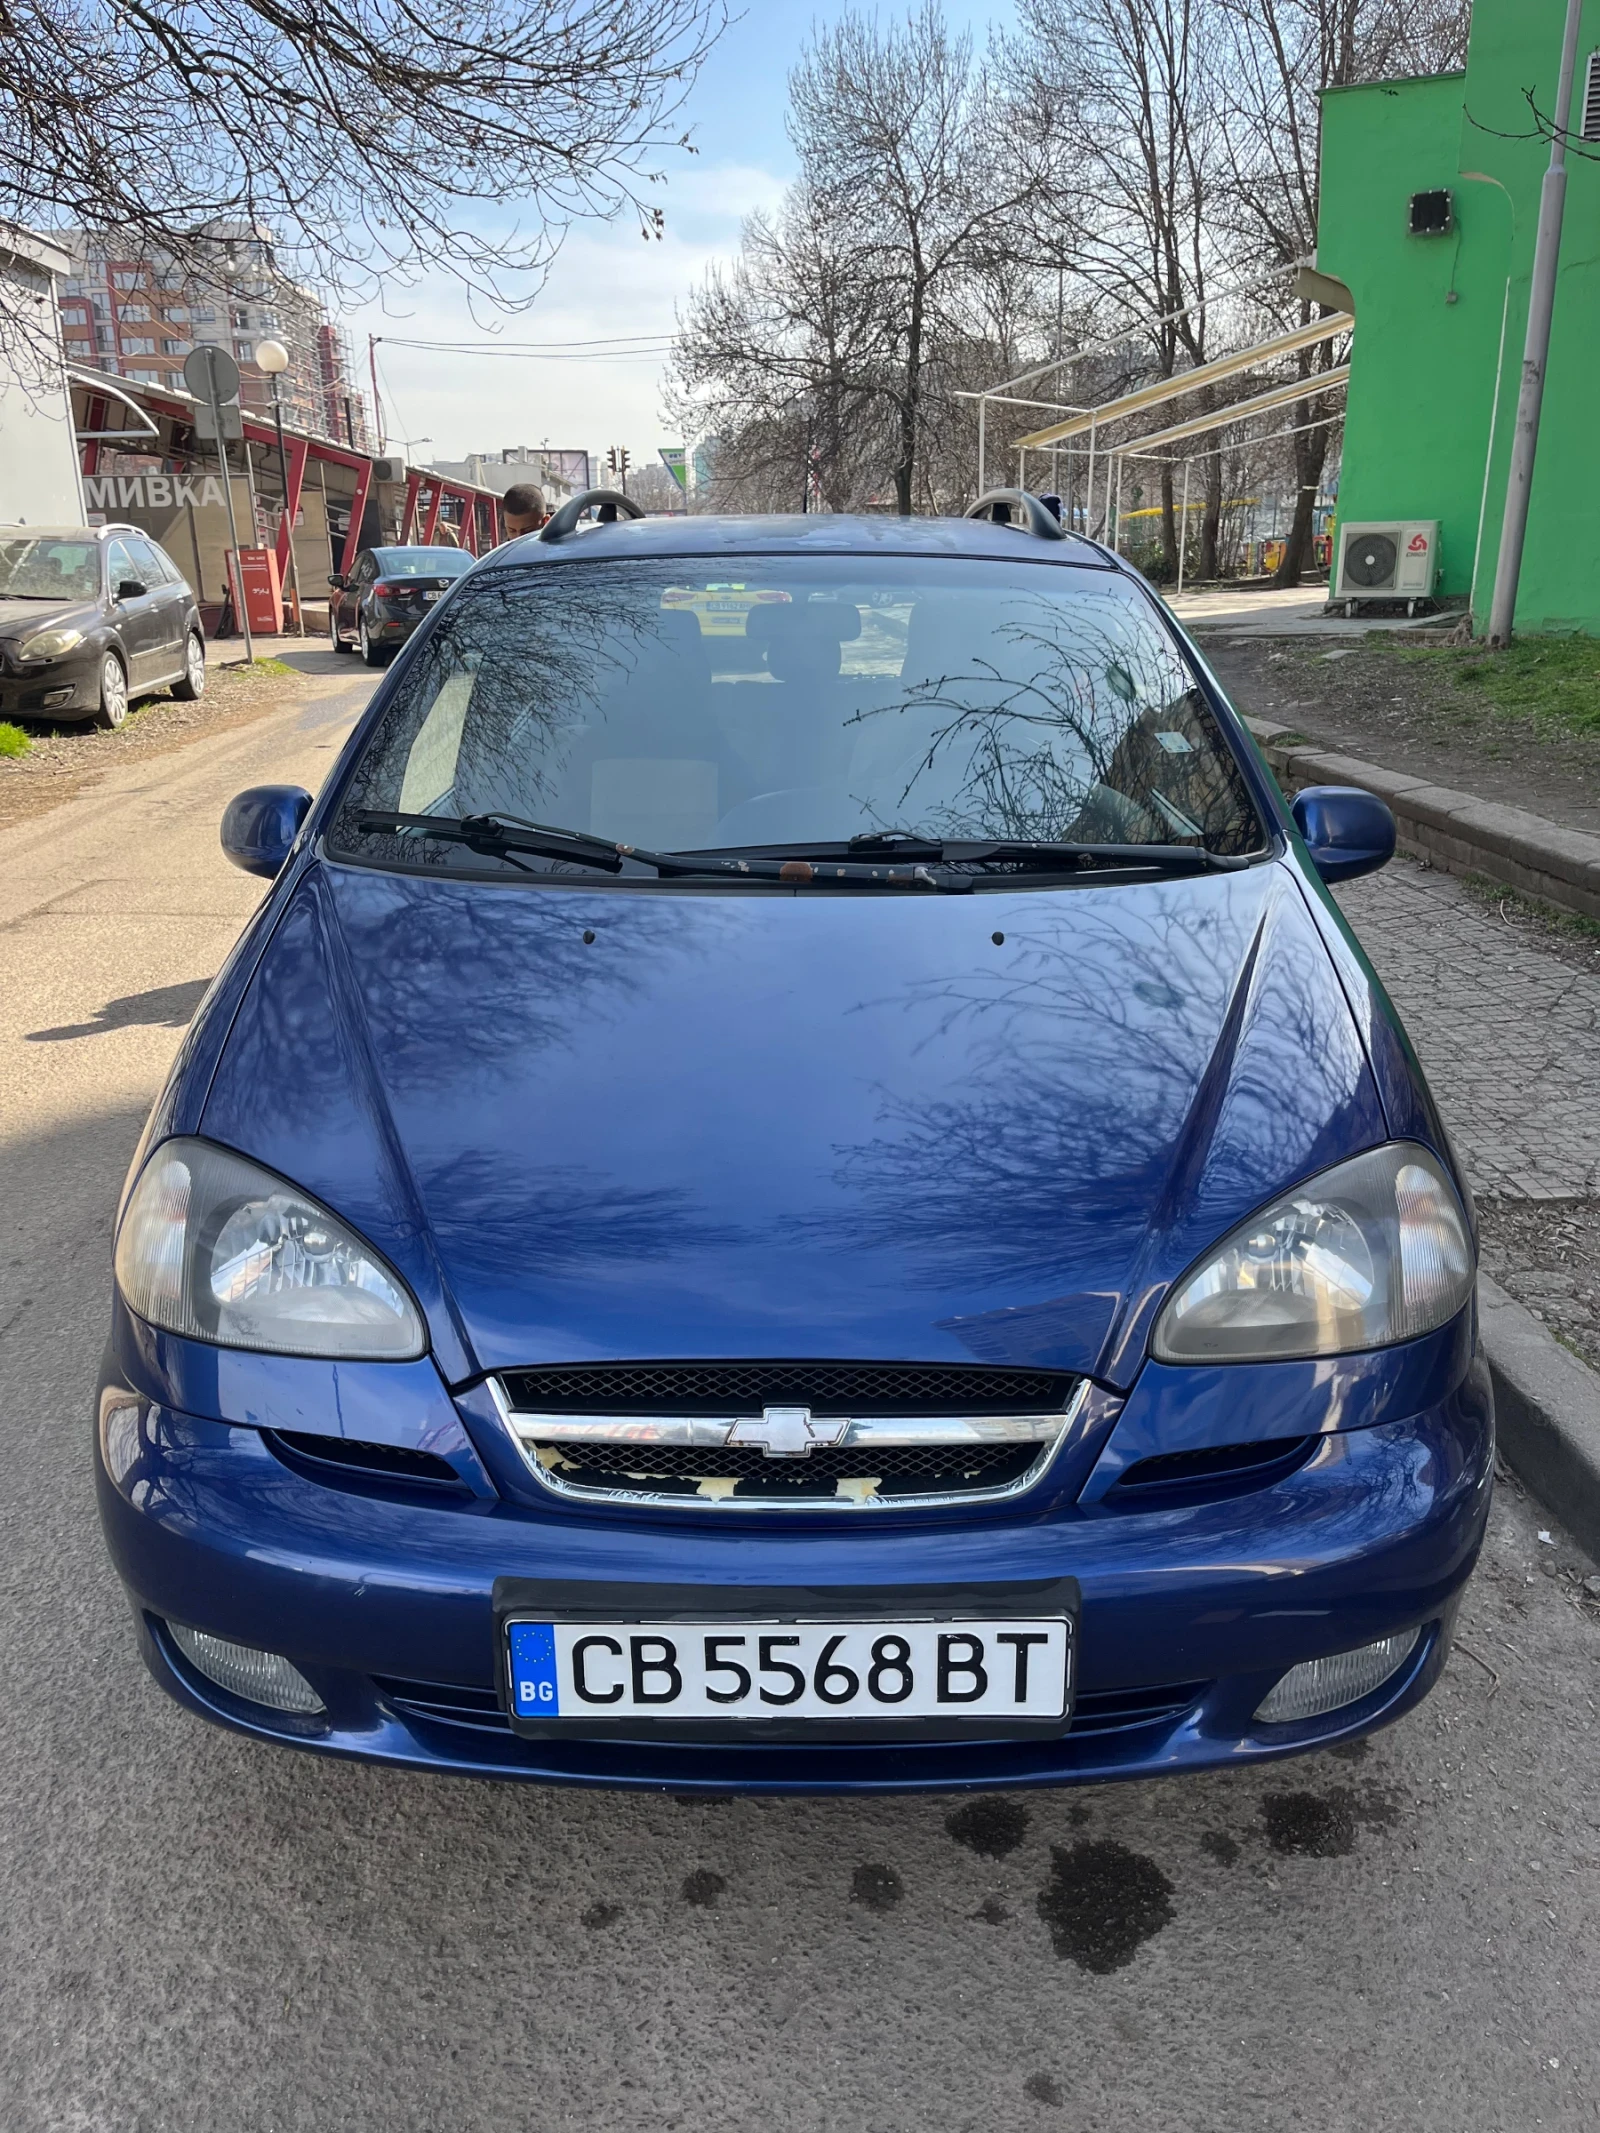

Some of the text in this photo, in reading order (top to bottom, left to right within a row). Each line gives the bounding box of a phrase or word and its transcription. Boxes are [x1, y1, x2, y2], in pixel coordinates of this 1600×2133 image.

[83, 475, 227, 509] МИВКА
[571, 1632, 1049, 1706] CB 5568 BT
[519, 1681, 554, 1702] BG
